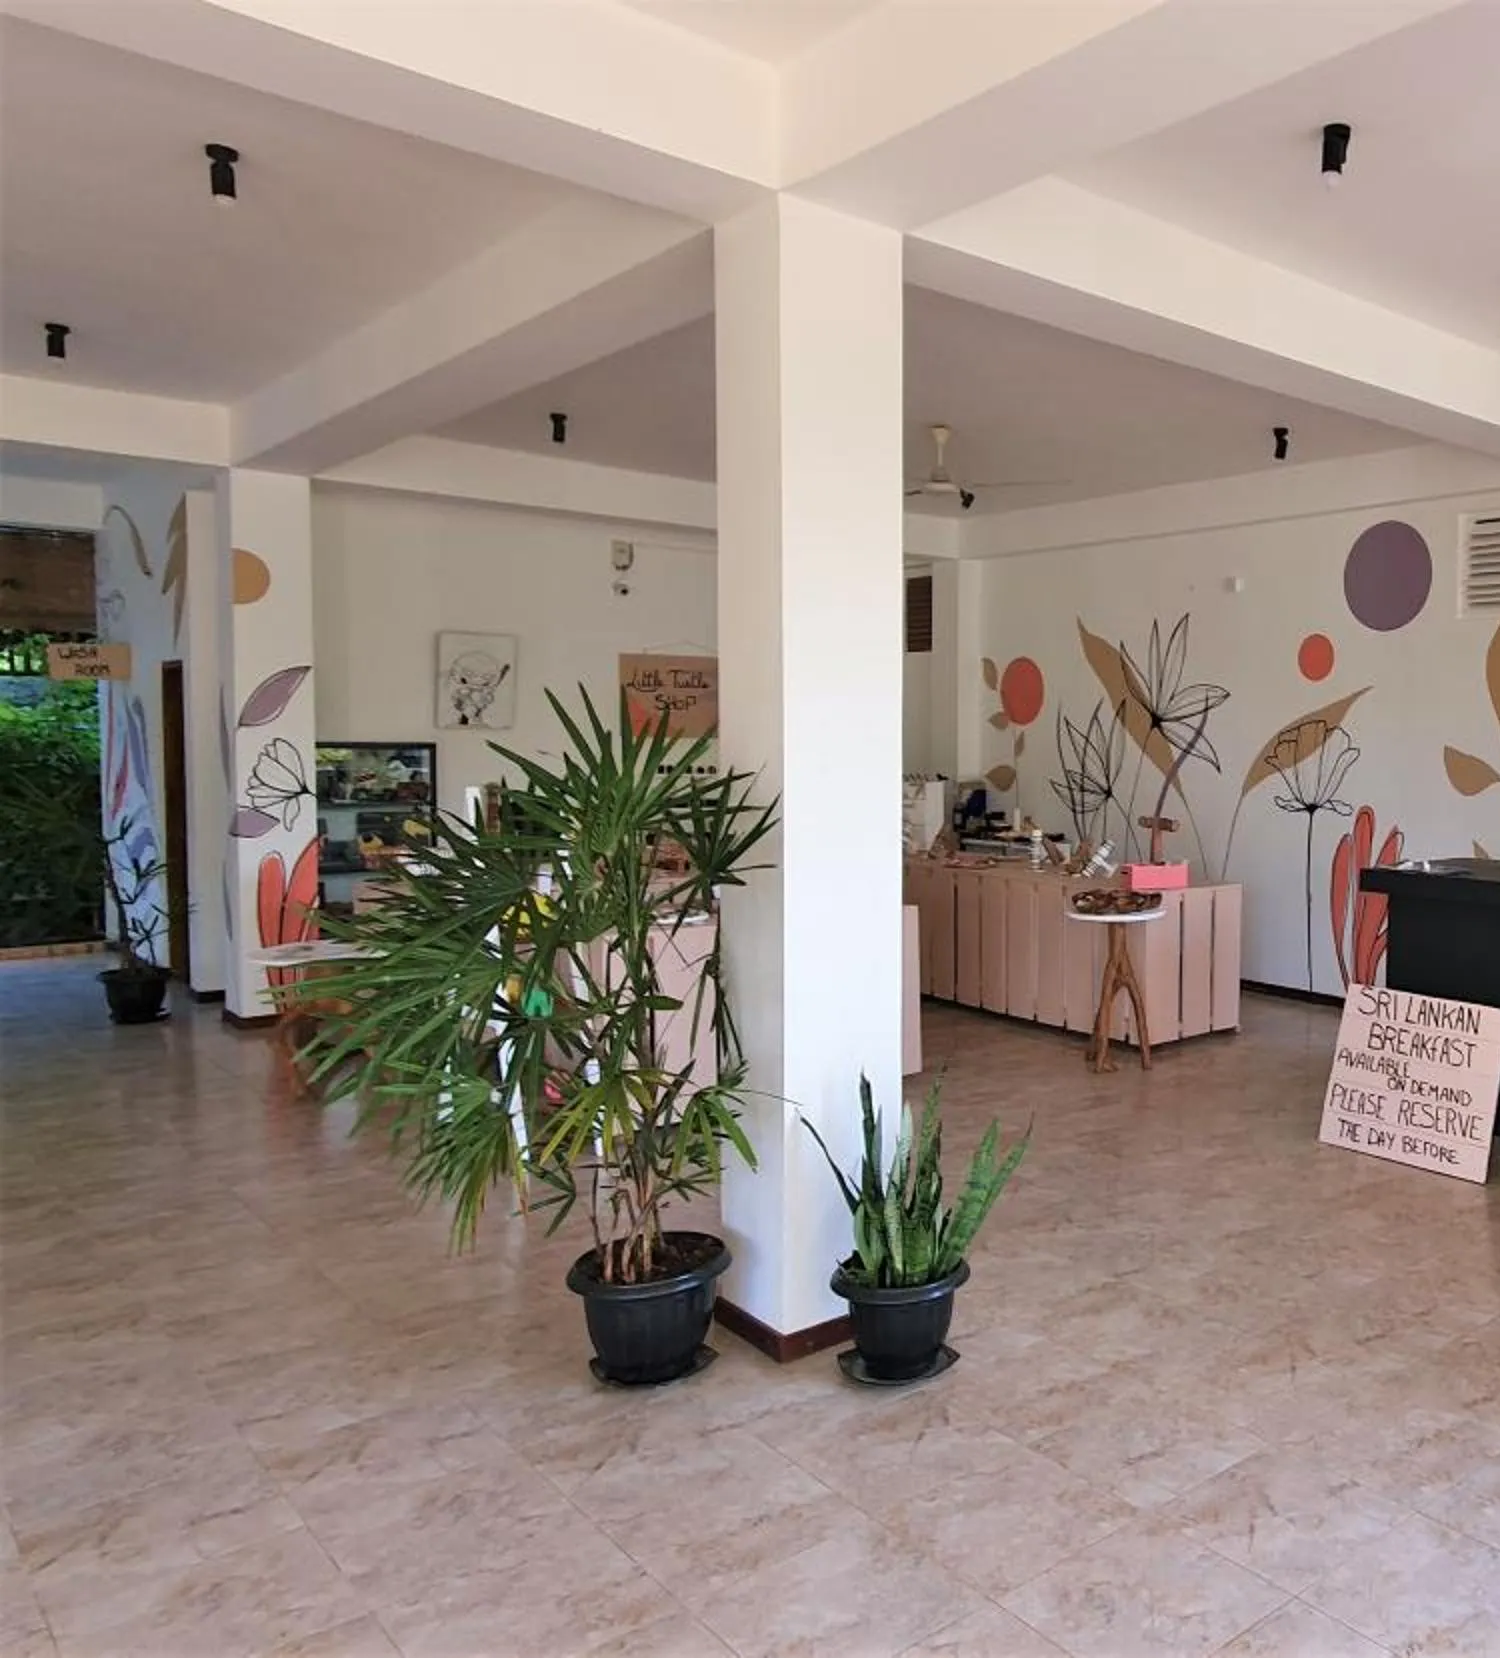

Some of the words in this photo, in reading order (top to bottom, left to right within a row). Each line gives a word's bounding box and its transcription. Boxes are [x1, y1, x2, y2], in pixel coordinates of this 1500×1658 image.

[75, 663, 111, 676] ROOM
[1357, 987, 1398, 1021] SRI
[1405, 996, 1481, 1035] LANKAN
[1337, 1048, 1410, 1079] AVAILABLE
[1367, 1022, 1477, 1068] BREAKFAST
[1329, 1083, 1388, 1121] PLEASE
[1397, 1099, 1485, 1141] RESERVE
[1387, 1077, 1406, 1092] ON
[1412, 1080, 1473, 1107] DEMAND
[1337, 1118, 1362, 1143] THE
[1367, 1127, 1397, 1150] DAY
[1402, 1135, 1461, 1165] BEFORE
